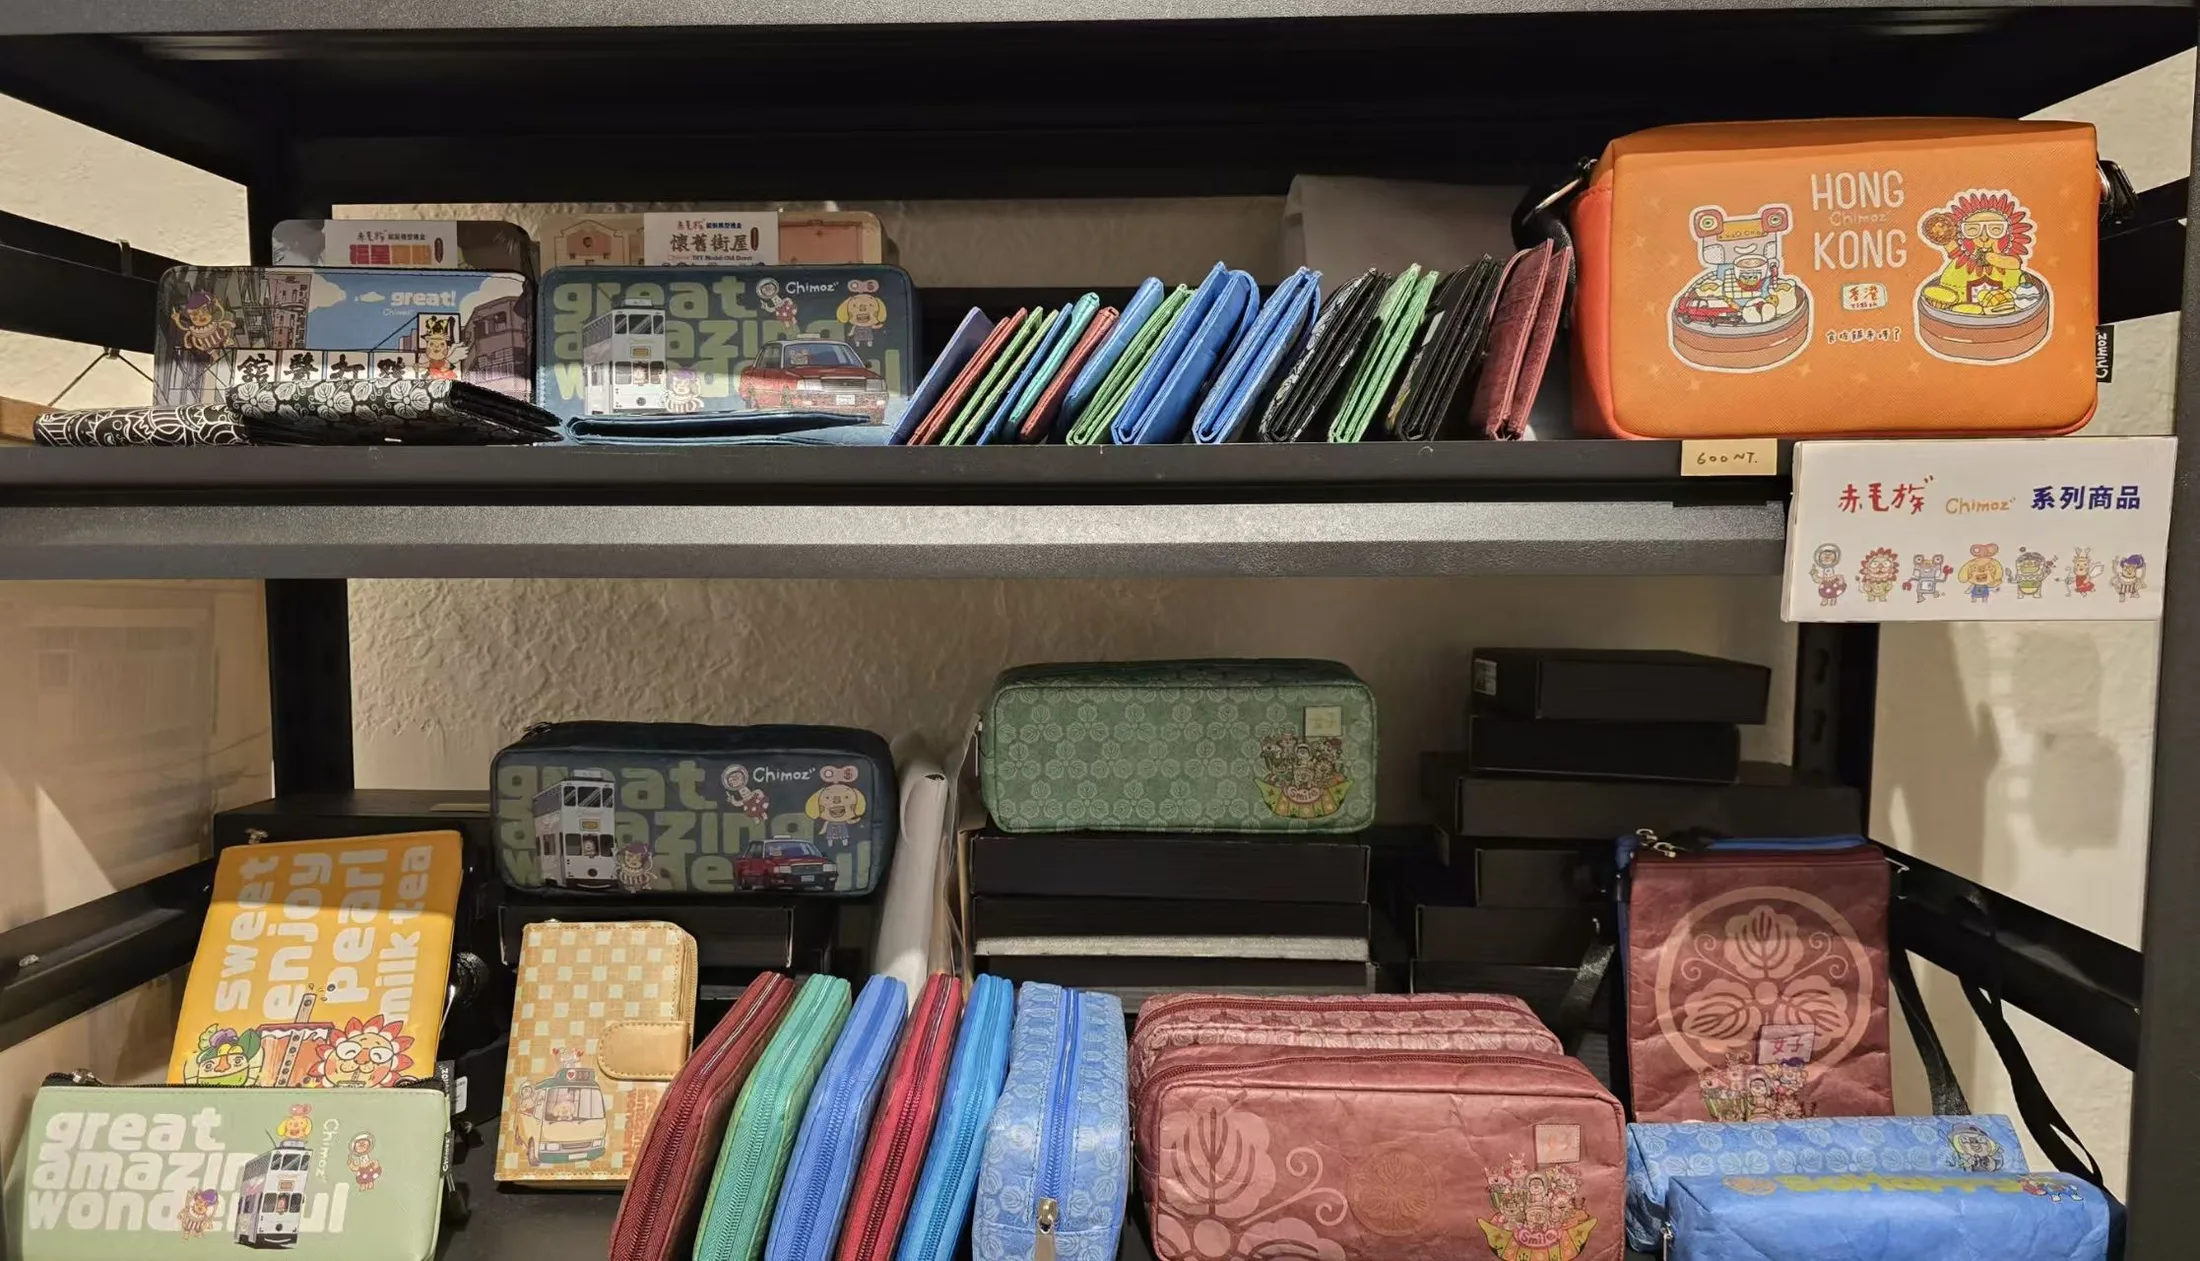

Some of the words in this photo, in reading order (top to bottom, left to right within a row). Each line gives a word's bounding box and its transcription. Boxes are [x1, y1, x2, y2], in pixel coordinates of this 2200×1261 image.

[1811, 170, 1905, 211] HONG
[670, 233, 749, 252] 懷舊街屋
[1814, 229, 1907, 271] KONG
[1849, 286, 1878, 301] 香港
[1697, 452, 1728, 465] 600
[2031, 485, 2141, 510] 系列商品
[388, 845, 434, 925] tea
[214, 855, 280, 1013] sweet
[263, 852, 333, 1020] enjoy
[375, 931, 421, 1026] milk
[45, 1107, 228, 1150] great
